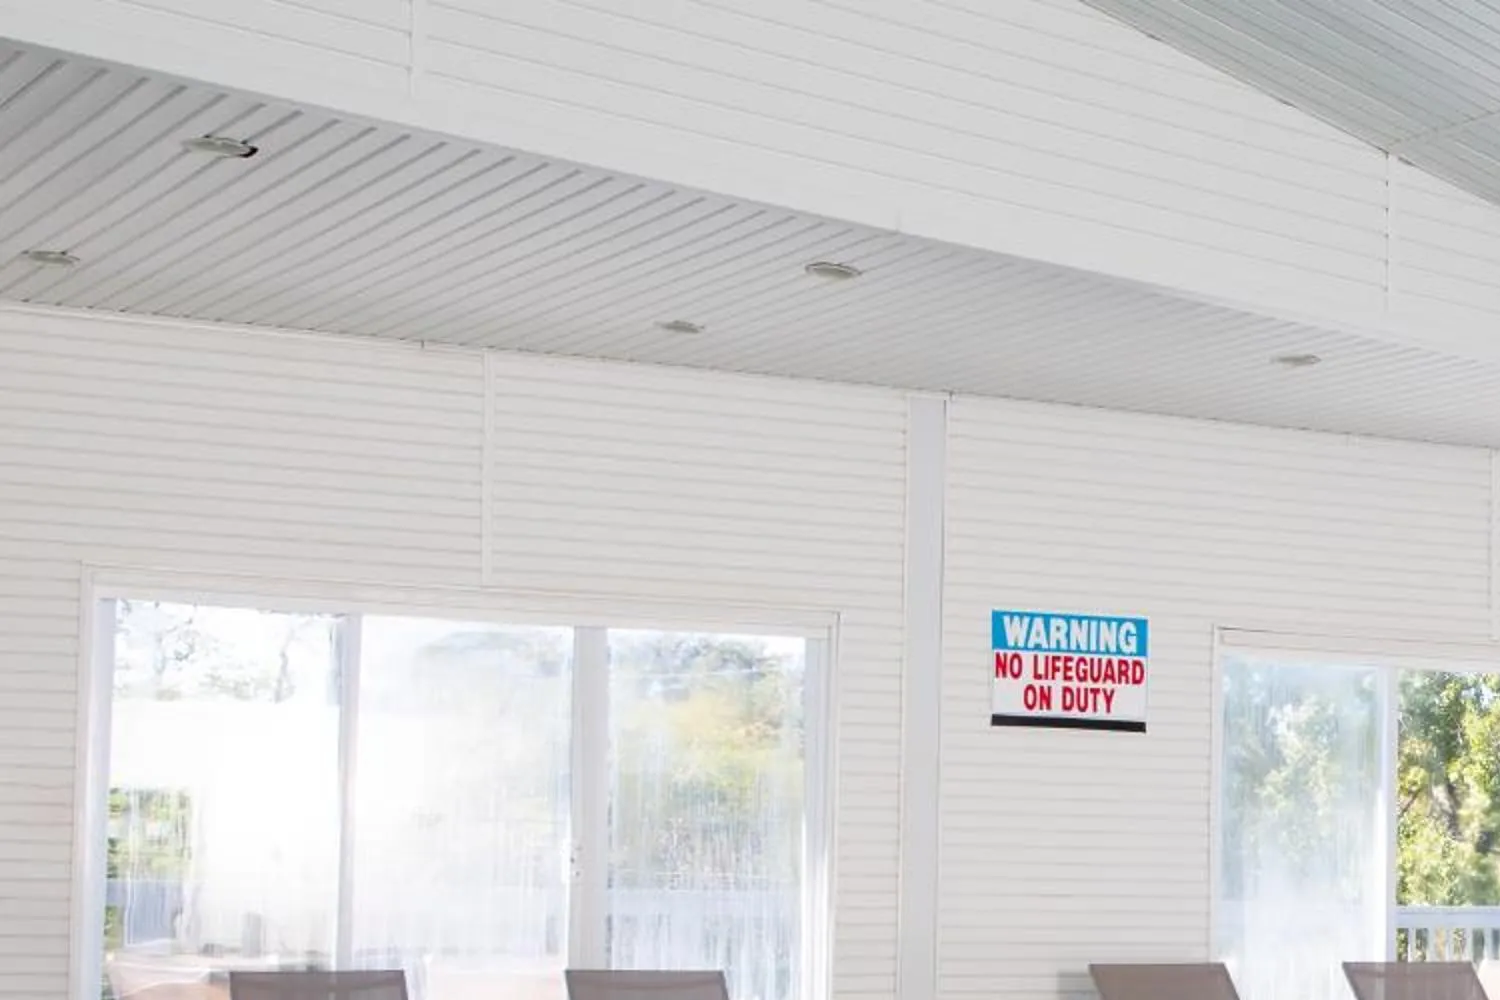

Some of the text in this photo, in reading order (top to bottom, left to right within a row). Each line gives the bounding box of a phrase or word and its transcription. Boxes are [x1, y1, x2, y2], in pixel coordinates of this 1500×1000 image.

[1003, 614, 1137, 655] WARNING
[995, 652, 1145, 685] NO LIFEGUARD
[1023, 684, 1115, 713] ON DUTY
